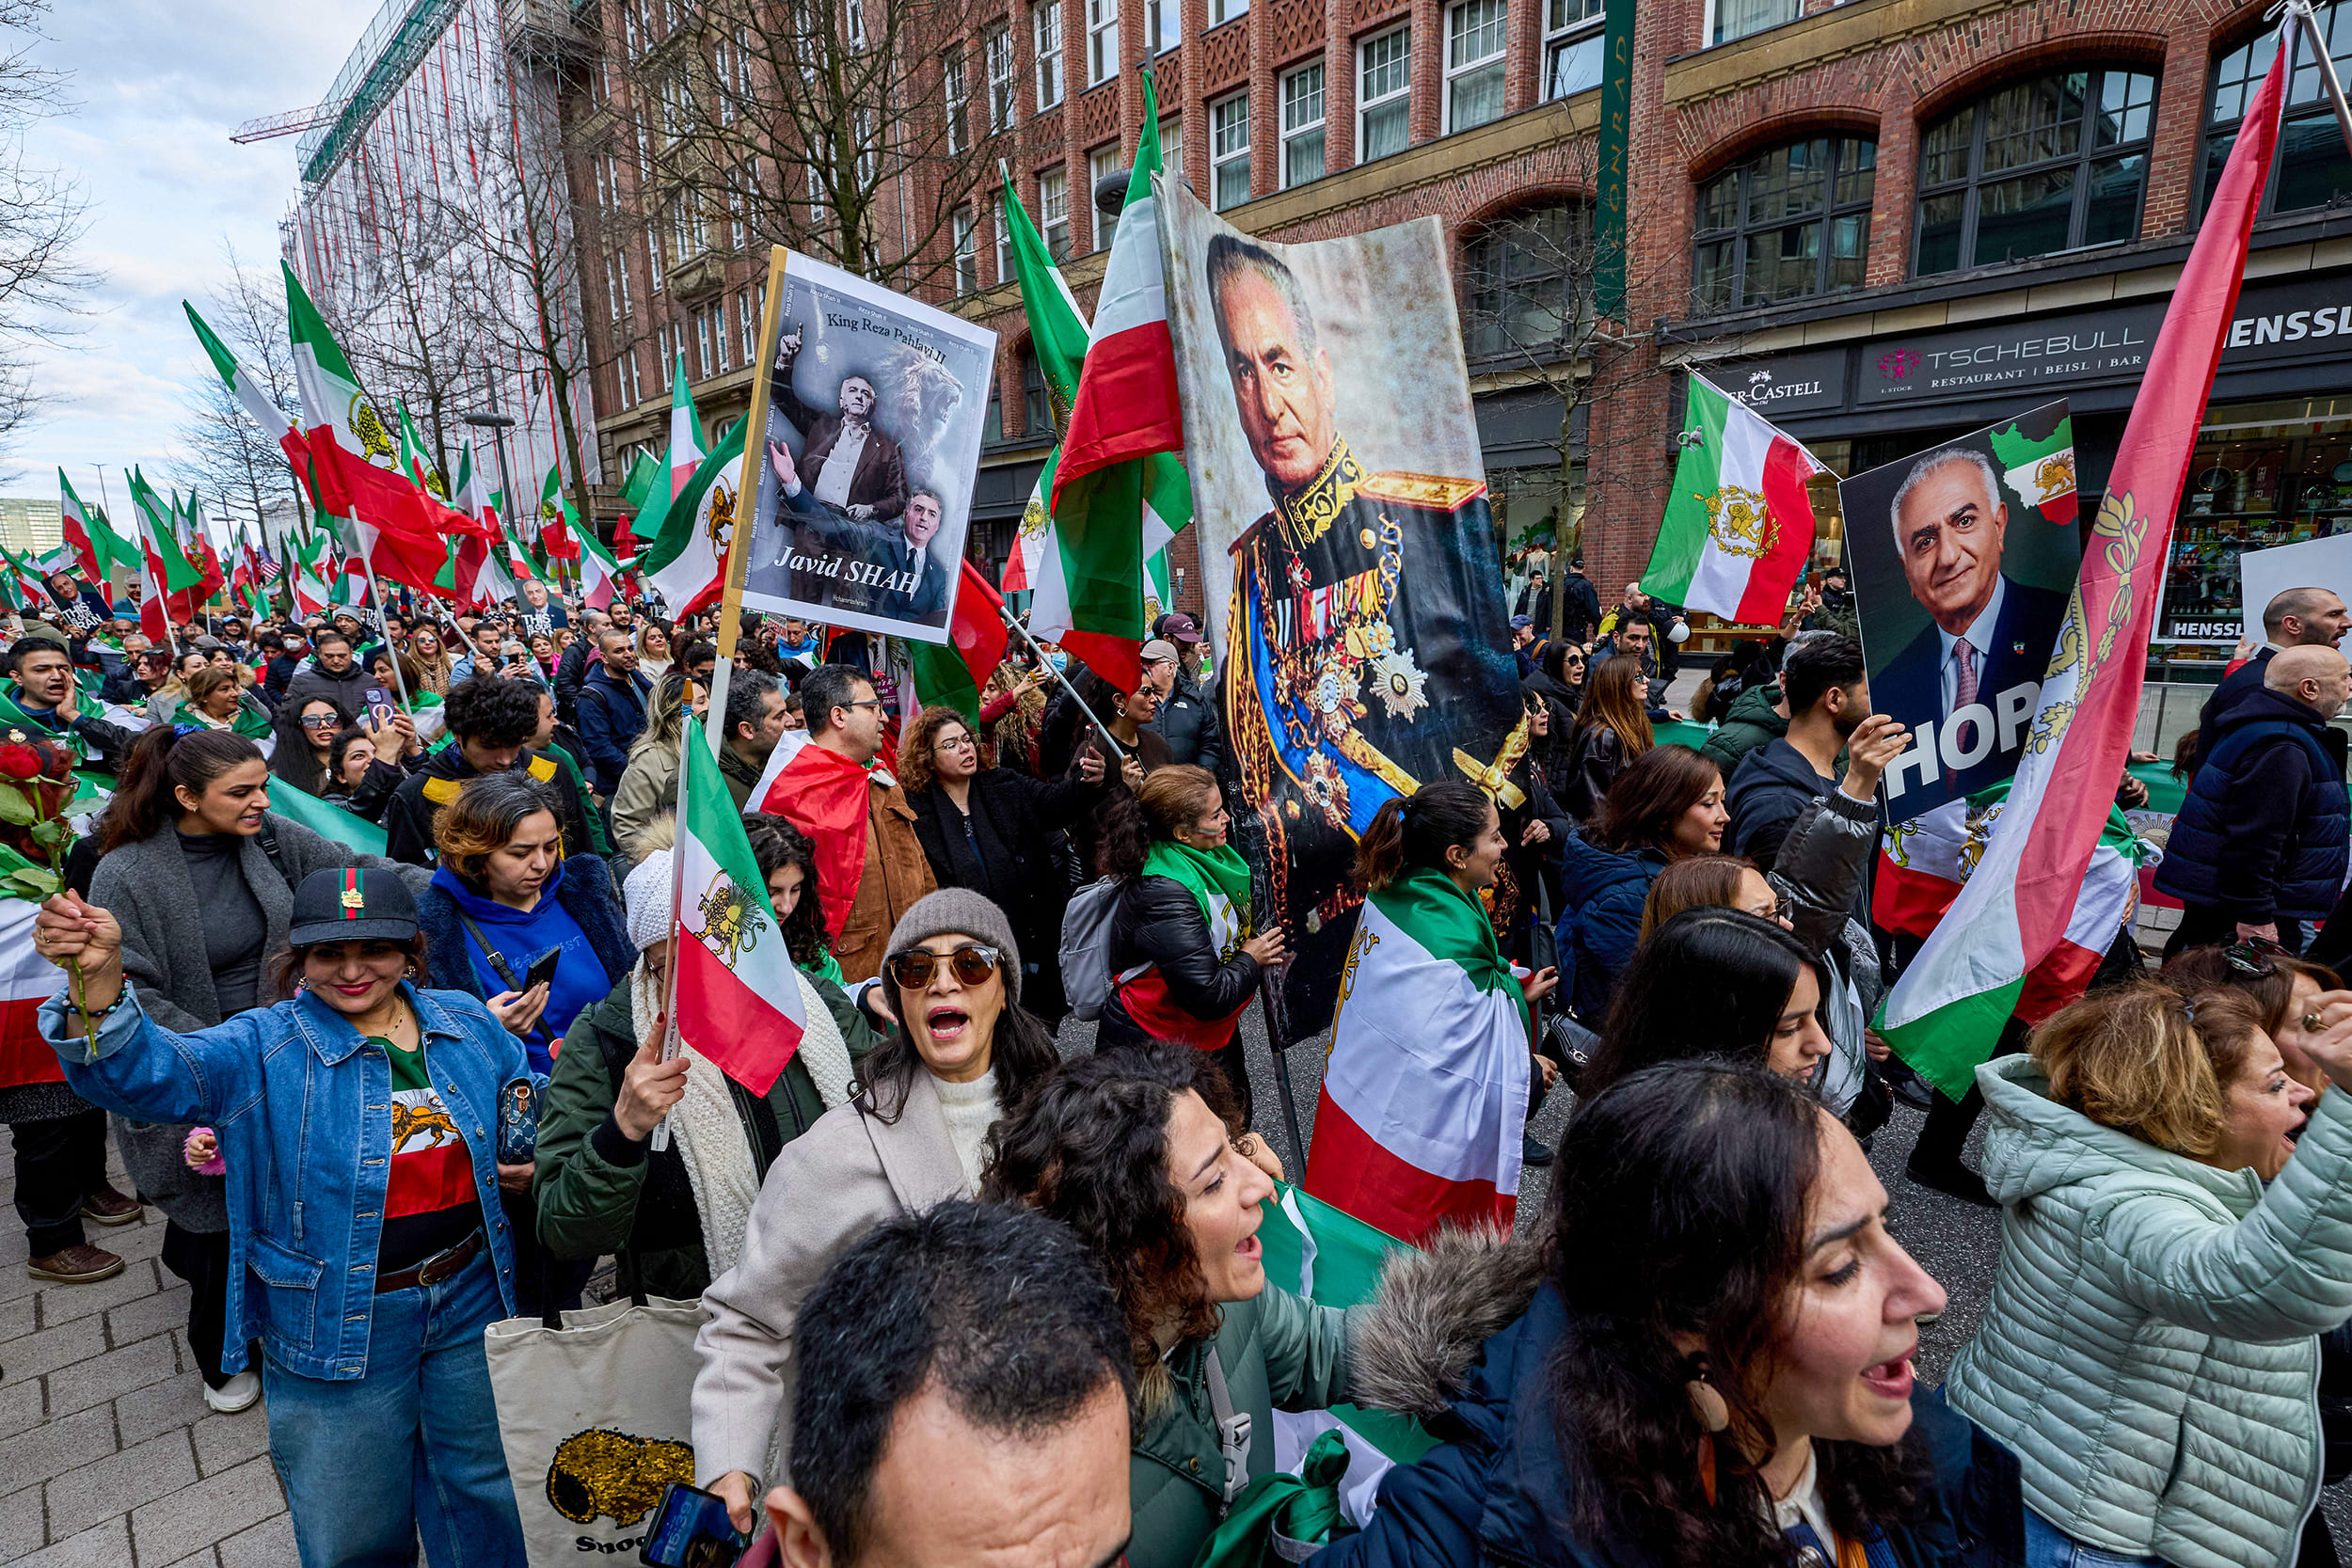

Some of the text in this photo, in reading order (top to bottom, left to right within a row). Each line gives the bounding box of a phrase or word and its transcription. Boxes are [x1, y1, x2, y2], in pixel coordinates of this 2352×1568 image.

[827, 313, 946, 365] King Reza Pahlavi II
[2222, 306, 2352, 349] ENSSL
[1927, 327, 2144, 370] TSCHEBULL
[1931, 355, 2143, 388] RESTAURANT BEISL BAR
[773, 546, 919, 594] Javid SHAH
[61, 602, 89, 619] THIS
[74, 613, 103, 630] RAN
[521, 613, 551, 624] THIS
